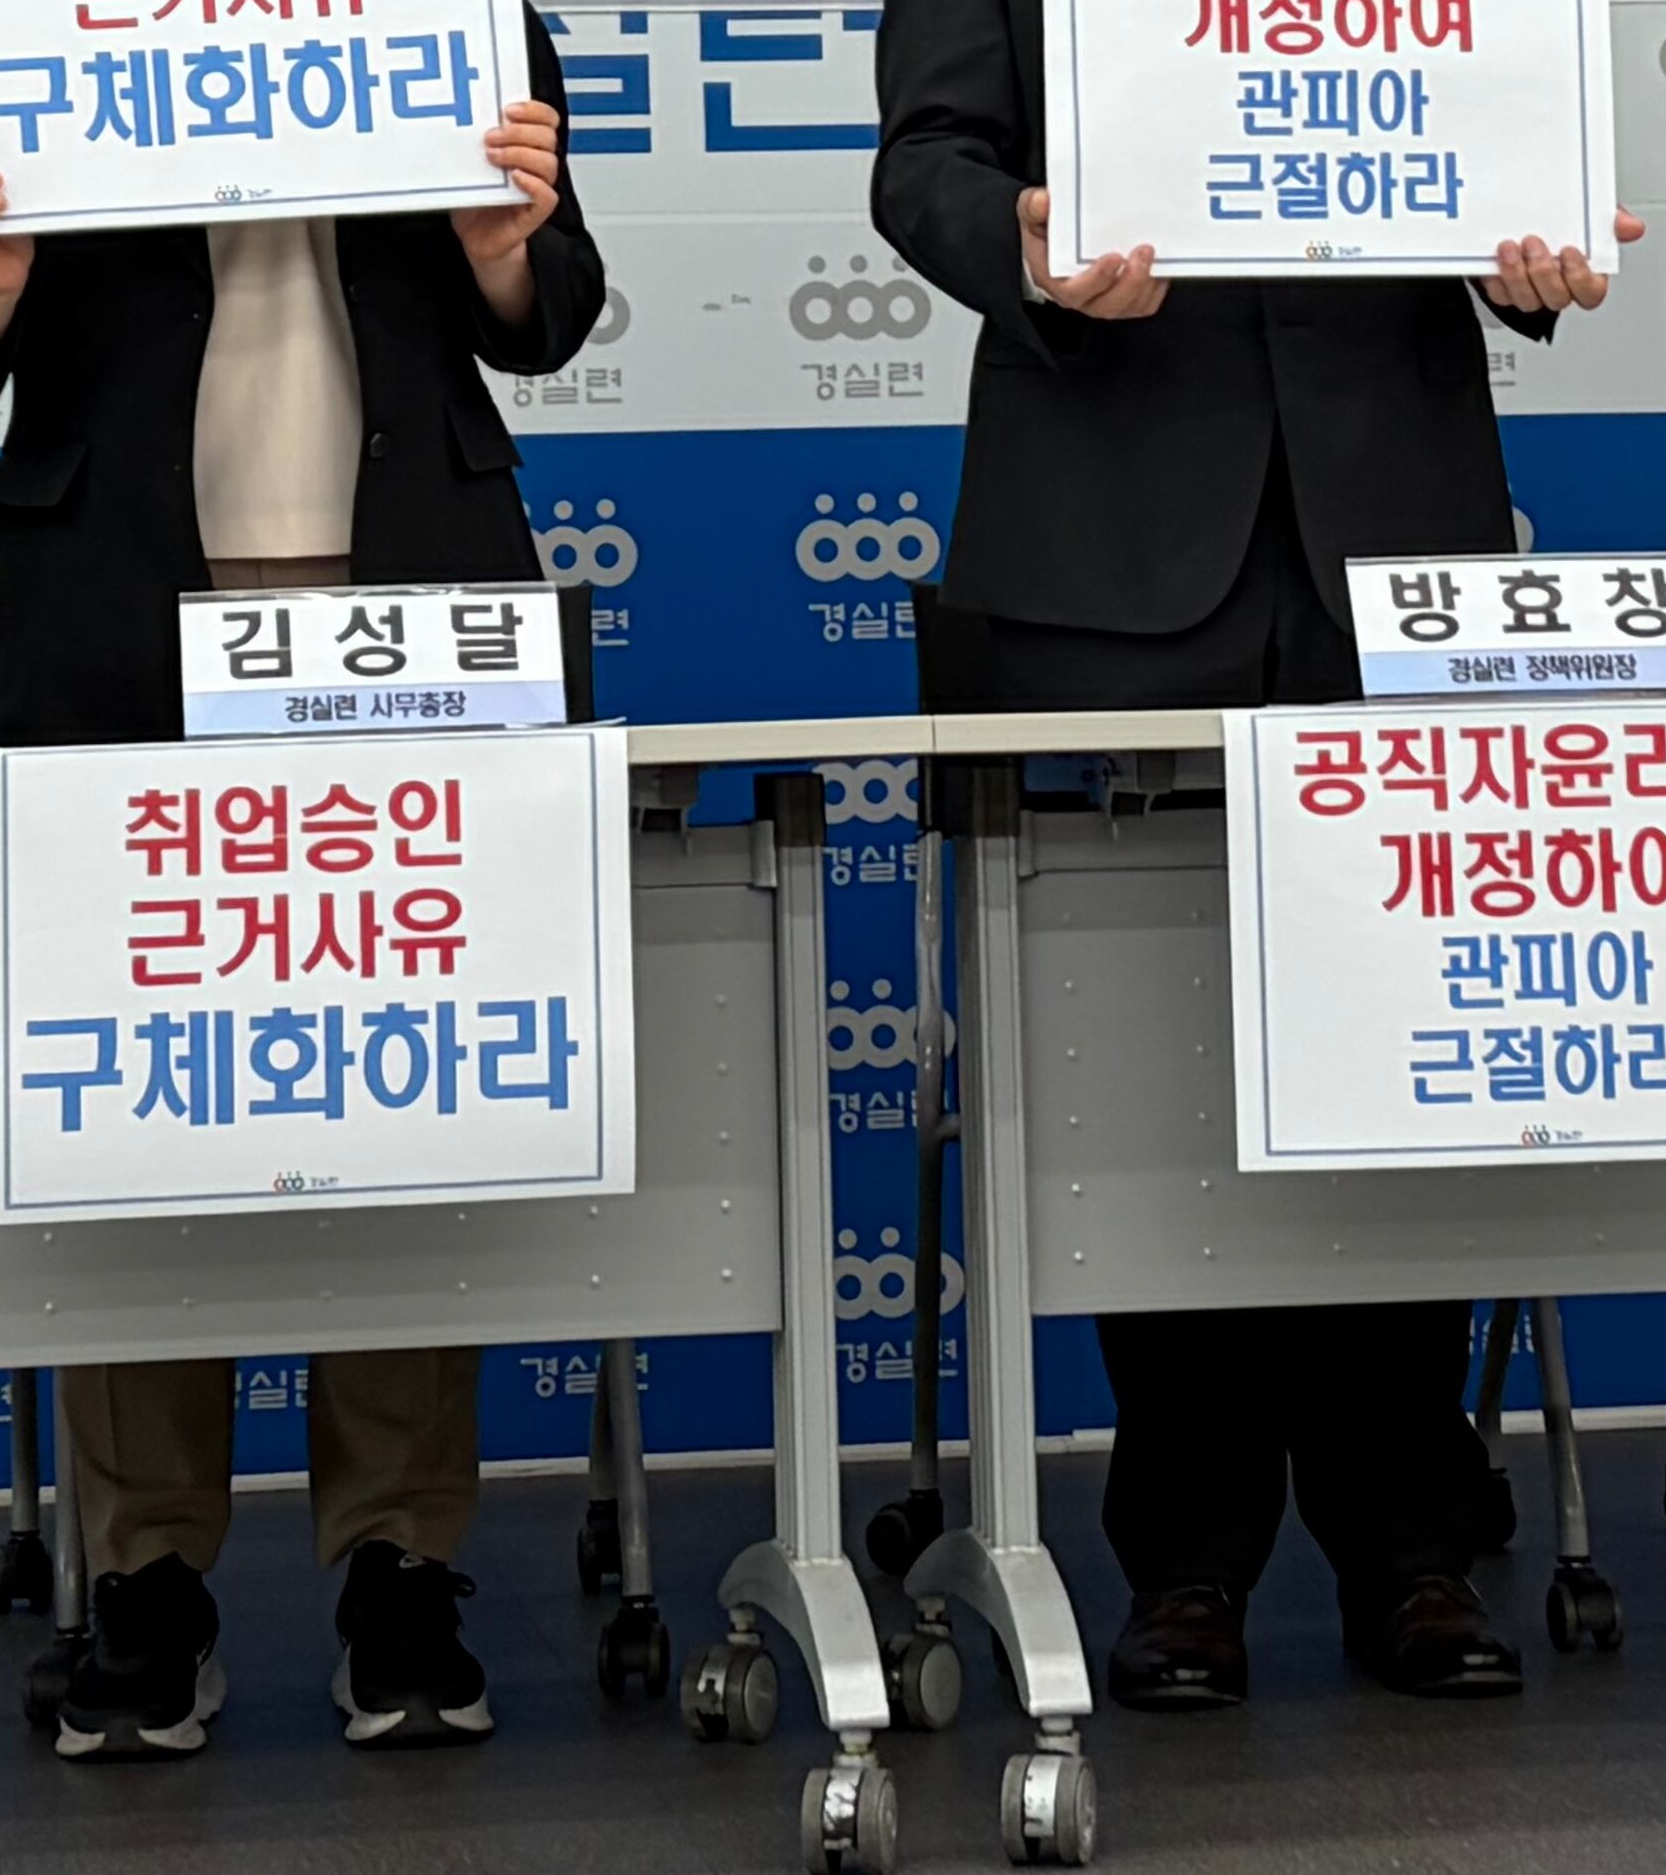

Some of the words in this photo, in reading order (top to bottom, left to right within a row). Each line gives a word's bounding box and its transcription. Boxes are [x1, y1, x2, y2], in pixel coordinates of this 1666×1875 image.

[1235, 69, 1430, 138] 관피아
[1206, 151, 1465, 221] 근절하라
[800, 361, 924, 401] 경실련
[1448, 655, 1517, 684] 경실련
[285, 694, 358, 723] 경실련
[369, 690, 467, 720] 사무총장
[124, 778, 464, 877] 취업승인
[126, 887, 468, 987] 근거사유
[1440, 929, 1654, 1011] 관피아
[21, 996, 579, 1132] 구체화하라
